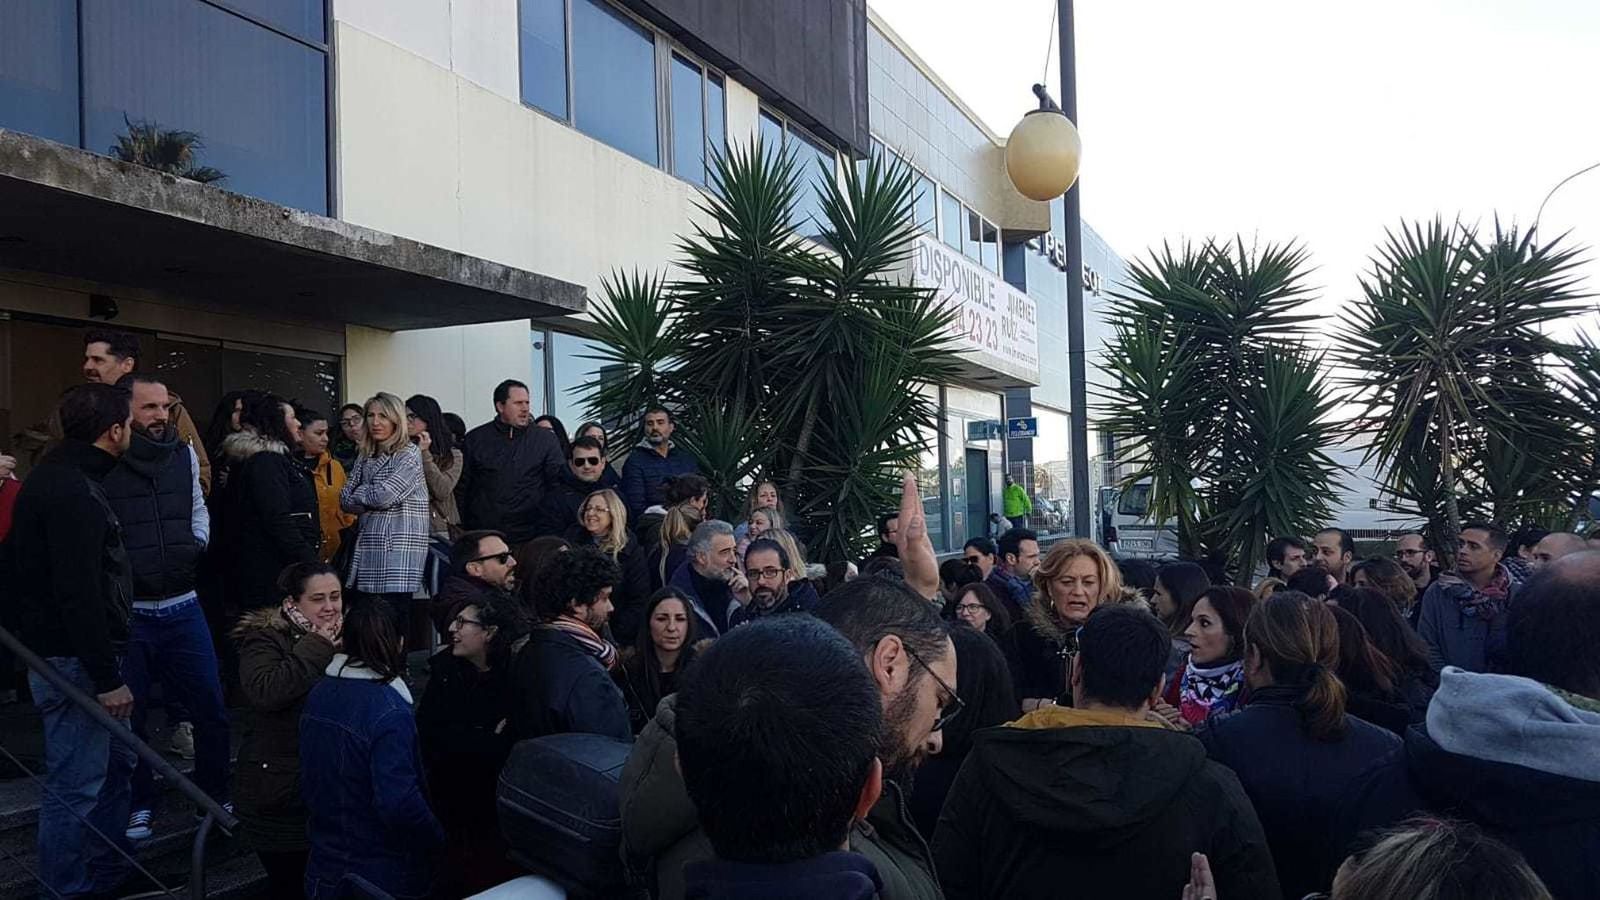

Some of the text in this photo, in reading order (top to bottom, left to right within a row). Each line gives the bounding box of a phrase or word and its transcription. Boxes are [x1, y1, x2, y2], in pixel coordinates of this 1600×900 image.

[919, 243, 996, 313] DISPONIBLE
[968, 308, 984, 346] 23
[985, 316, 999, 351] 23
[1001, 314, 1018, 342] RUIZ
